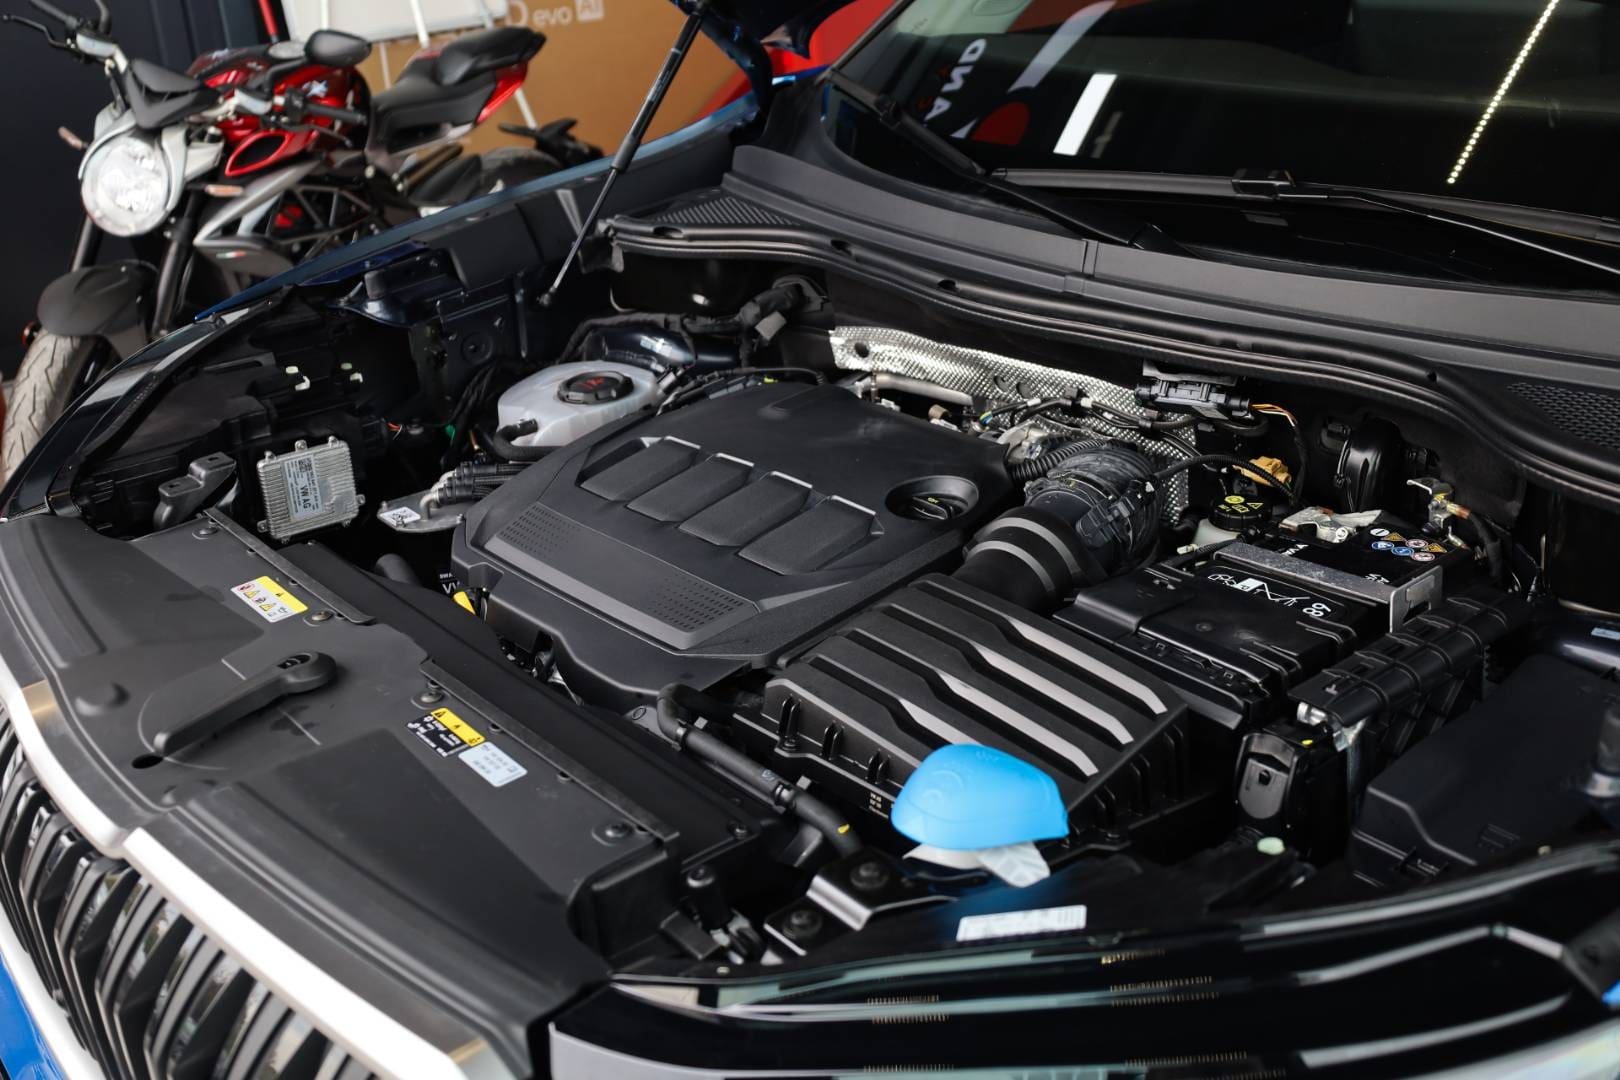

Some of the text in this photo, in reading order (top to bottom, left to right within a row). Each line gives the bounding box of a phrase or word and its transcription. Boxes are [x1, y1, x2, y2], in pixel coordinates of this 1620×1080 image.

[532, 6, 573, 26] evo
[302, 498, 311, 509] AG
[1302, 602, 1331, 617] 68
